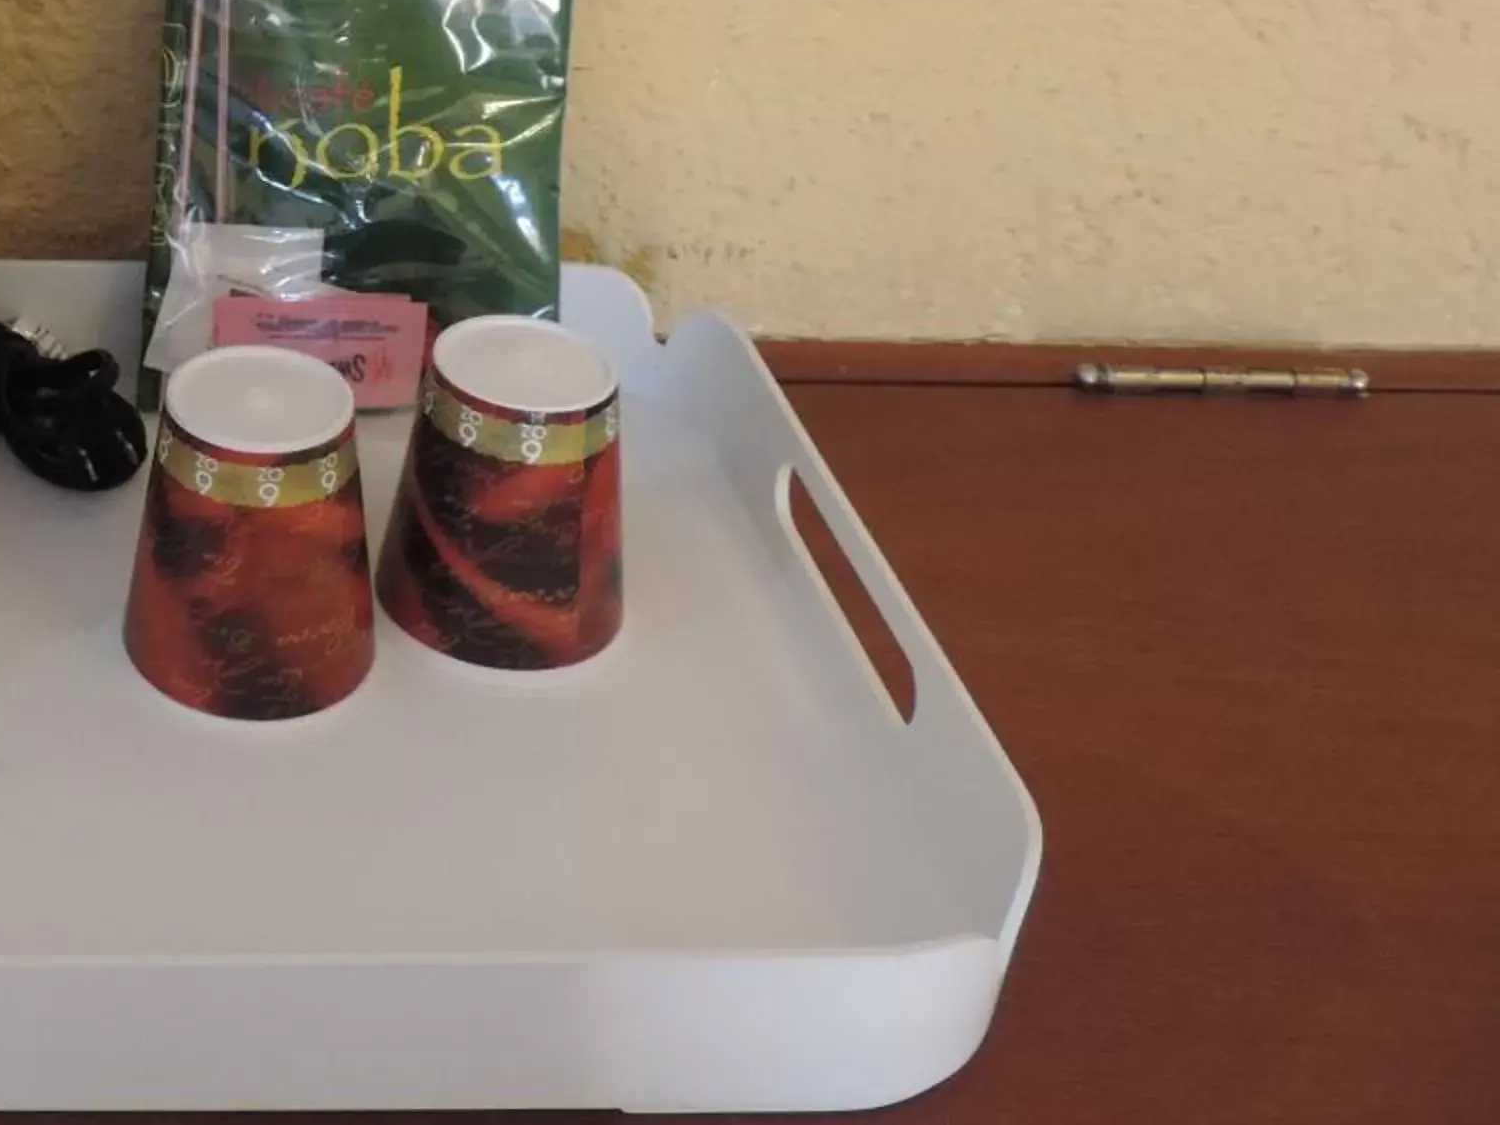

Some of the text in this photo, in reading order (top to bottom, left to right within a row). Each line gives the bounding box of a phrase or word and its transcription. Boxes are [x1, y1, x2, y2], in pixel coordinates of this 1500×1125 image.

[520, 438, 544, 465] 6
[194, 469, 214, 496] 6
[259, 482, 281, 508] 6
